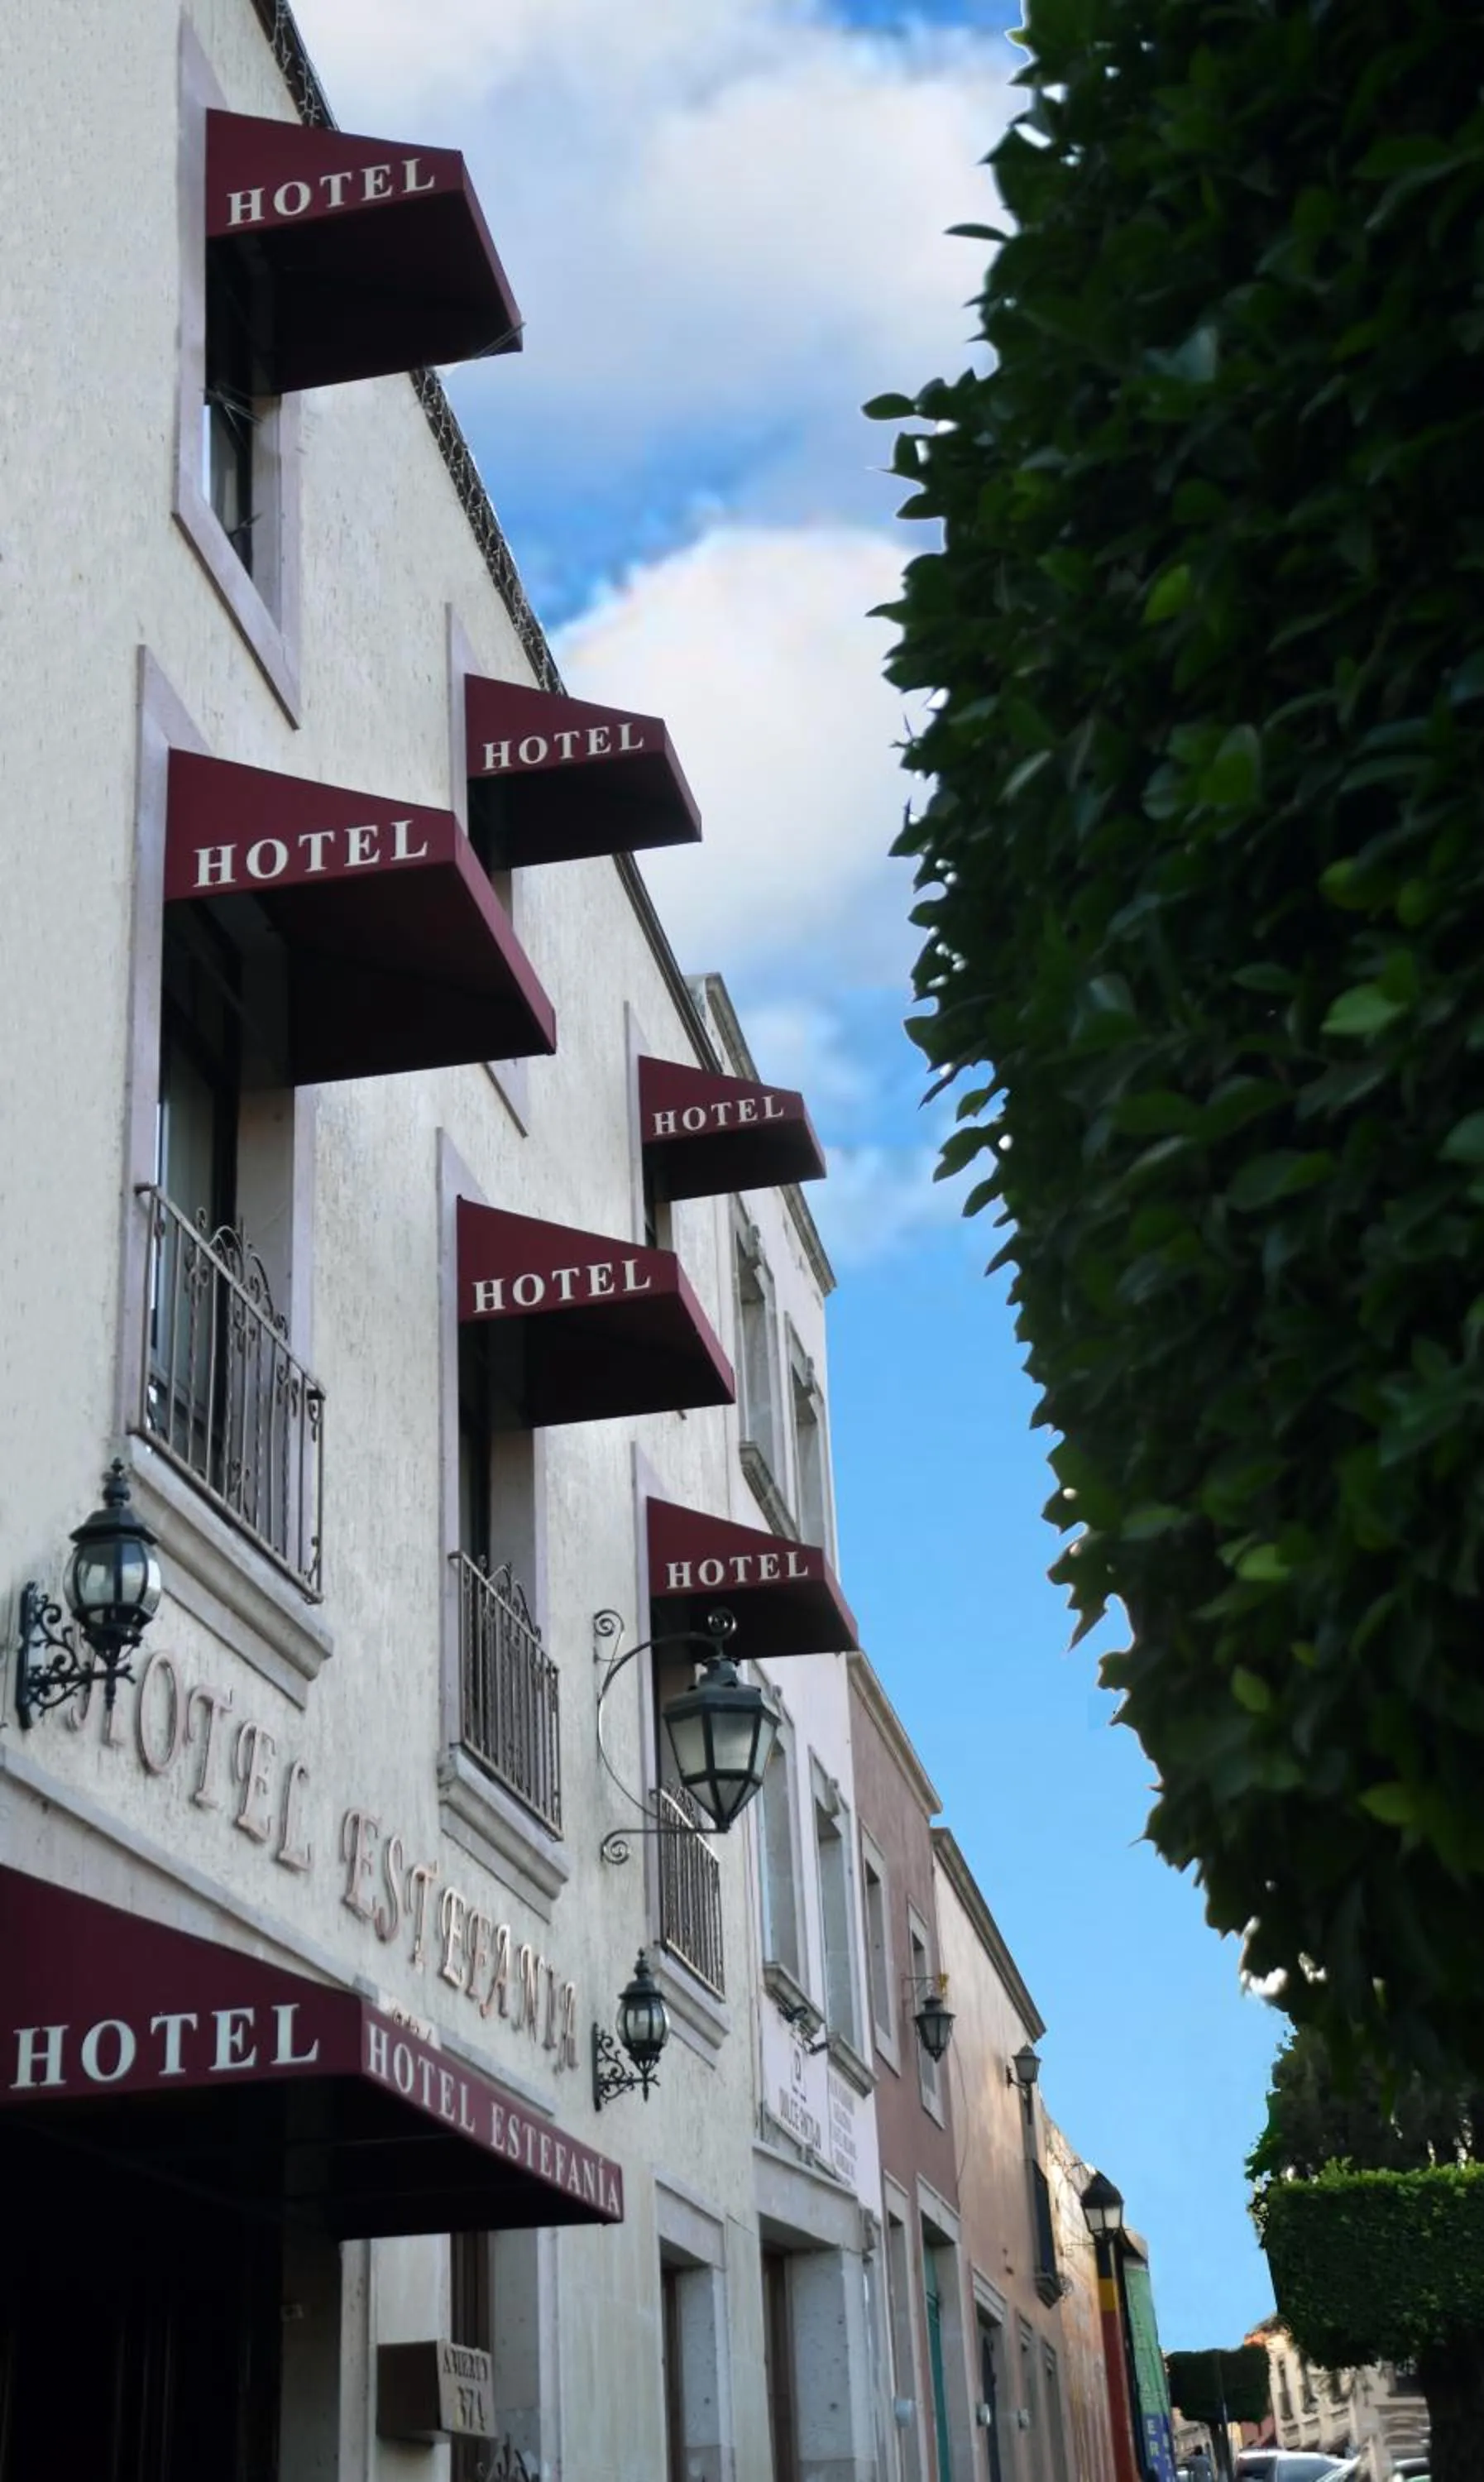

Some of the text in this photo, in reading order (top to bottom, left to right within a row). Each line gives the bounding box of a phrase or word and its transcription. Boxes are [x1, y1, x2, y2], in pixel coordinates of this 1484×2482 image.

[227, 157, 436, 227] HOTEL
[482, 721, 645, 771] HOTEL
[193, 819, 429, 888] HOTEL
[652, 1094, 785, 1137] HOTEL
[472, 1258, 652, 1314] HOTEL
[665, 1550, 810, 1589] HOTEL
[340, 1807, 580, 2075] ESTEFANIA
[9, 2003, 321, 2090] HOTEL
[366, 2021, 476, 2135] HOTEL
